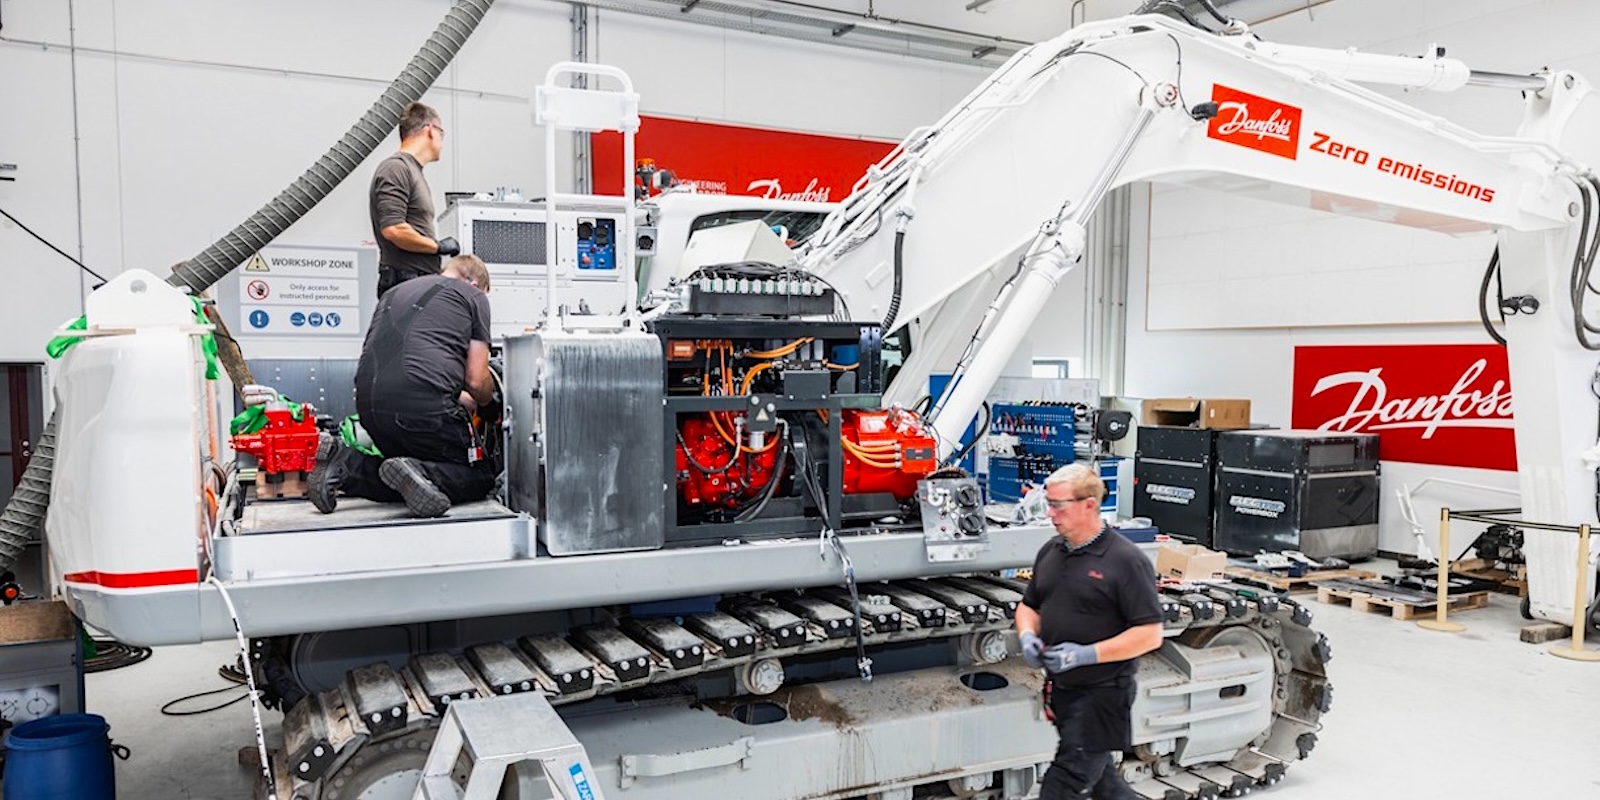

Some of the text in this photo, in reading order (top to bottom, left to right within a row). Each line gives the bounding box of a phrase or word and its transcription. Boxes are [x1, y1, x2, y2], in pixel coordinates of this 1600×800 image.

[1217, 101, 1292, 141] Danfoss
[1309, 131, 1496, 203] Zero emissions
[747, 177, 831, 202] Danfoss
[271, 257, 355, 269] WORKSHOP ZONE
[279, 292, 314, 300] instructed
[289, 283, 306, 292] Only
[1310, 358, 1514, 439] Danfoss
[1235, 506, 1279, 518] POWERBOX
